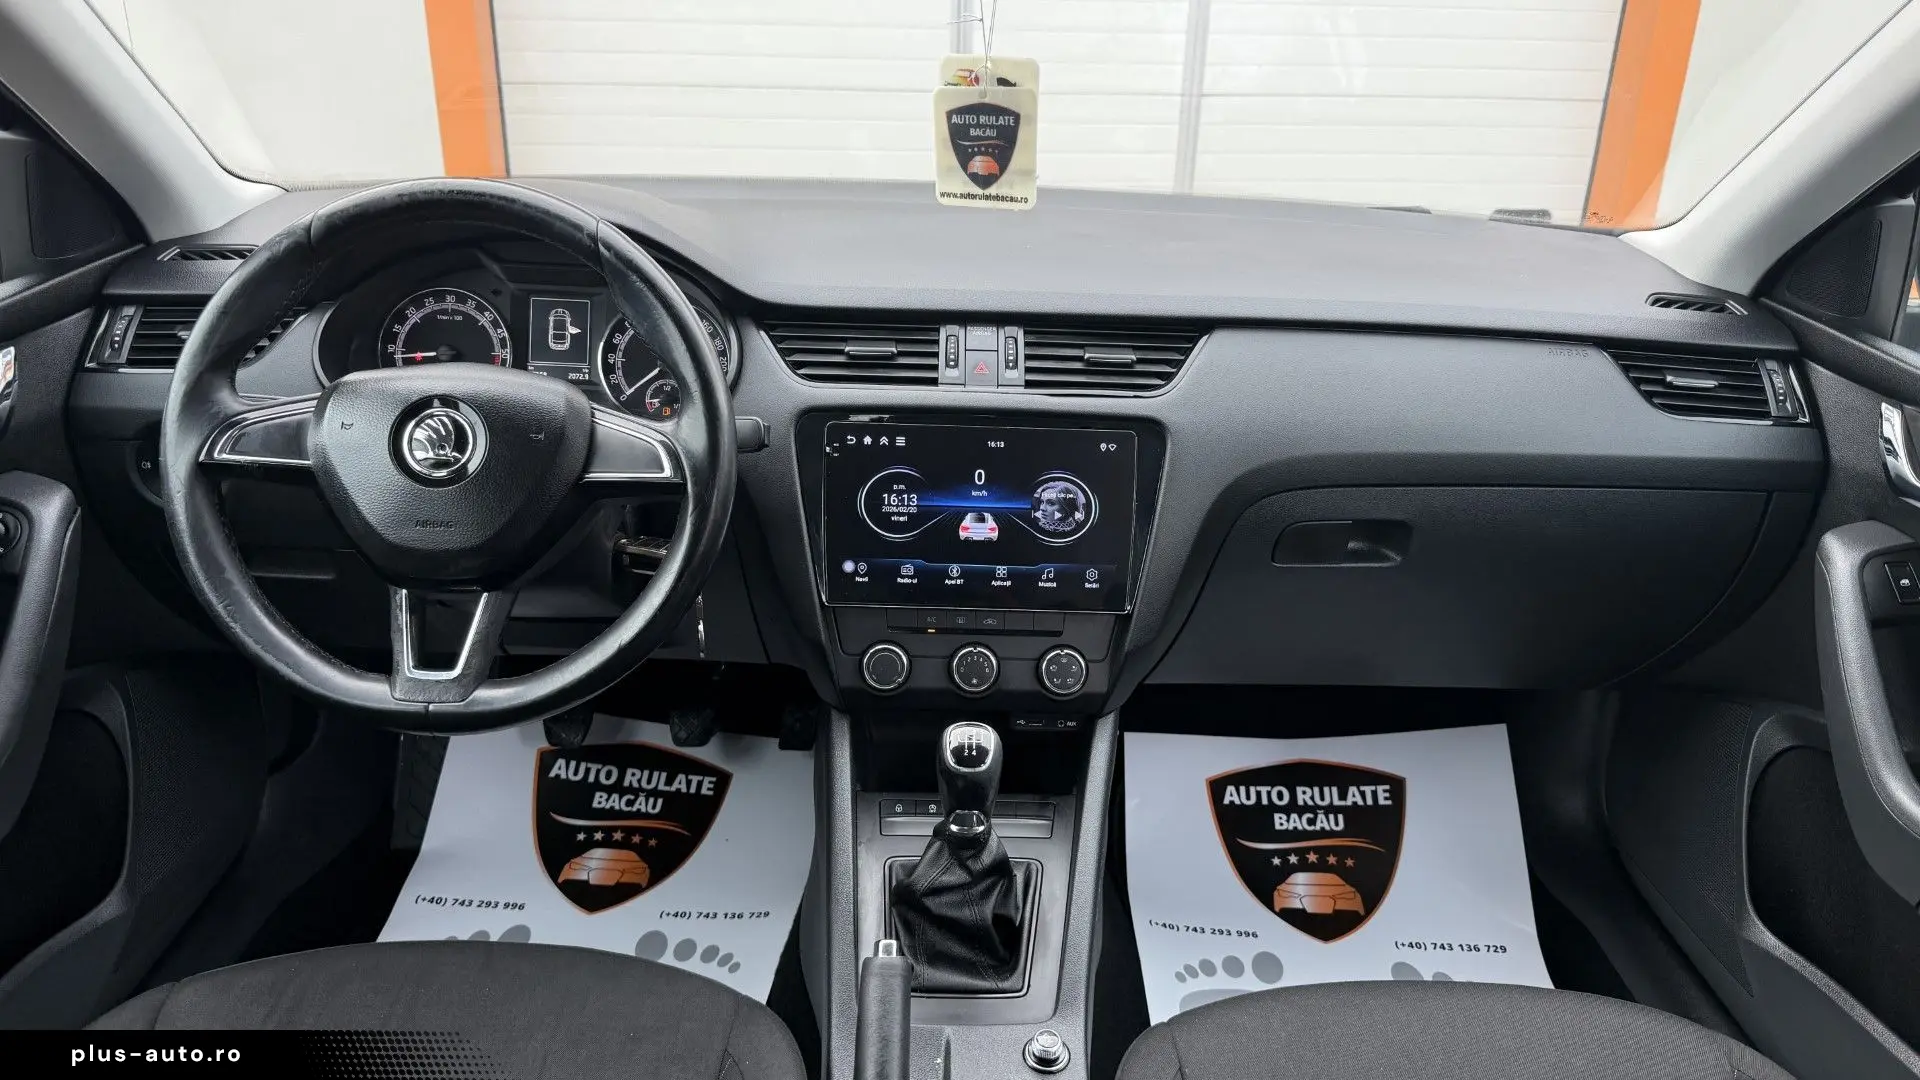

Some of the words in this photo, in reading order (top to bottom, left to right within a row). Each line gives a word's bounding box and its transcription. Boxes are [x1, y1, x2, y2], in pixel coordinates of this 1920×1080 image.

[951, 114, 977, 125] AUTO
[979, 115, 1015, 126] RULATE
[939, 190, 1029, 203] www.autorulatebacau.ro
[424, 297, 435, 306] 25
[445, 295, 456, 303] 30
[466, 298, 477, 308] 35
[405, 307, 416, 318] 20
[483, 310, 495, 321] 40
[392, 324, 402, 333] 15
[496, 328, 506, 339] 45
[612, 333, 623, 344] 60
[714, 336, 725, 352] 180
[387, 344, 396, 353] 10
[501, 348, 510, 359] 50
[1548, 347, 1590, 358] AIRBAG
[607, 353, 616, 365] 40
[609, 374, 619, 385] 20
[620, 394, 628, 402] 0
[974, 469, 986, 485] 0
[971, 489, 988, 498] km/h
[882, 493, 918, 506] 16:13
[881, 505, 918, 513] 2026/02/20
[414, 519, 454, 530] AIRBAG
[548, 757, 618, 786] AUTO
[622, 767, 717, 796] RULATE
[1222, 784, 1290, 806] AUTO
[1296, 784, 1393, 807] RULATE
[591, 790, 664, 815] BACĂU
[1273, 808, 1345, 832] BACĂU
[415, 893, 448, 907] (+40)
[451, 897, 474, 909] 743
[477, 898, 500, 910] 293
[503, 900, 526, 912] 996
[659, 909, 692, 921] (+40)
[696, 910, 720, 921] 743
[722, 910, 745, 921] 136
[748, 909, 771, 920] 729
[1148, 918, 1181, 933] (+40)
[1184, 925, 1206, 936] 743
[1209, 927, 1233, 938] 293
[1236, 929, 1259, 940] 996
[1394, 940, 1428, 952] (+40)
[1430, 942, 1454, 953] 743
[1458, 943, 1481, 954] 136
[1484, 943, 1508, 955] 729
